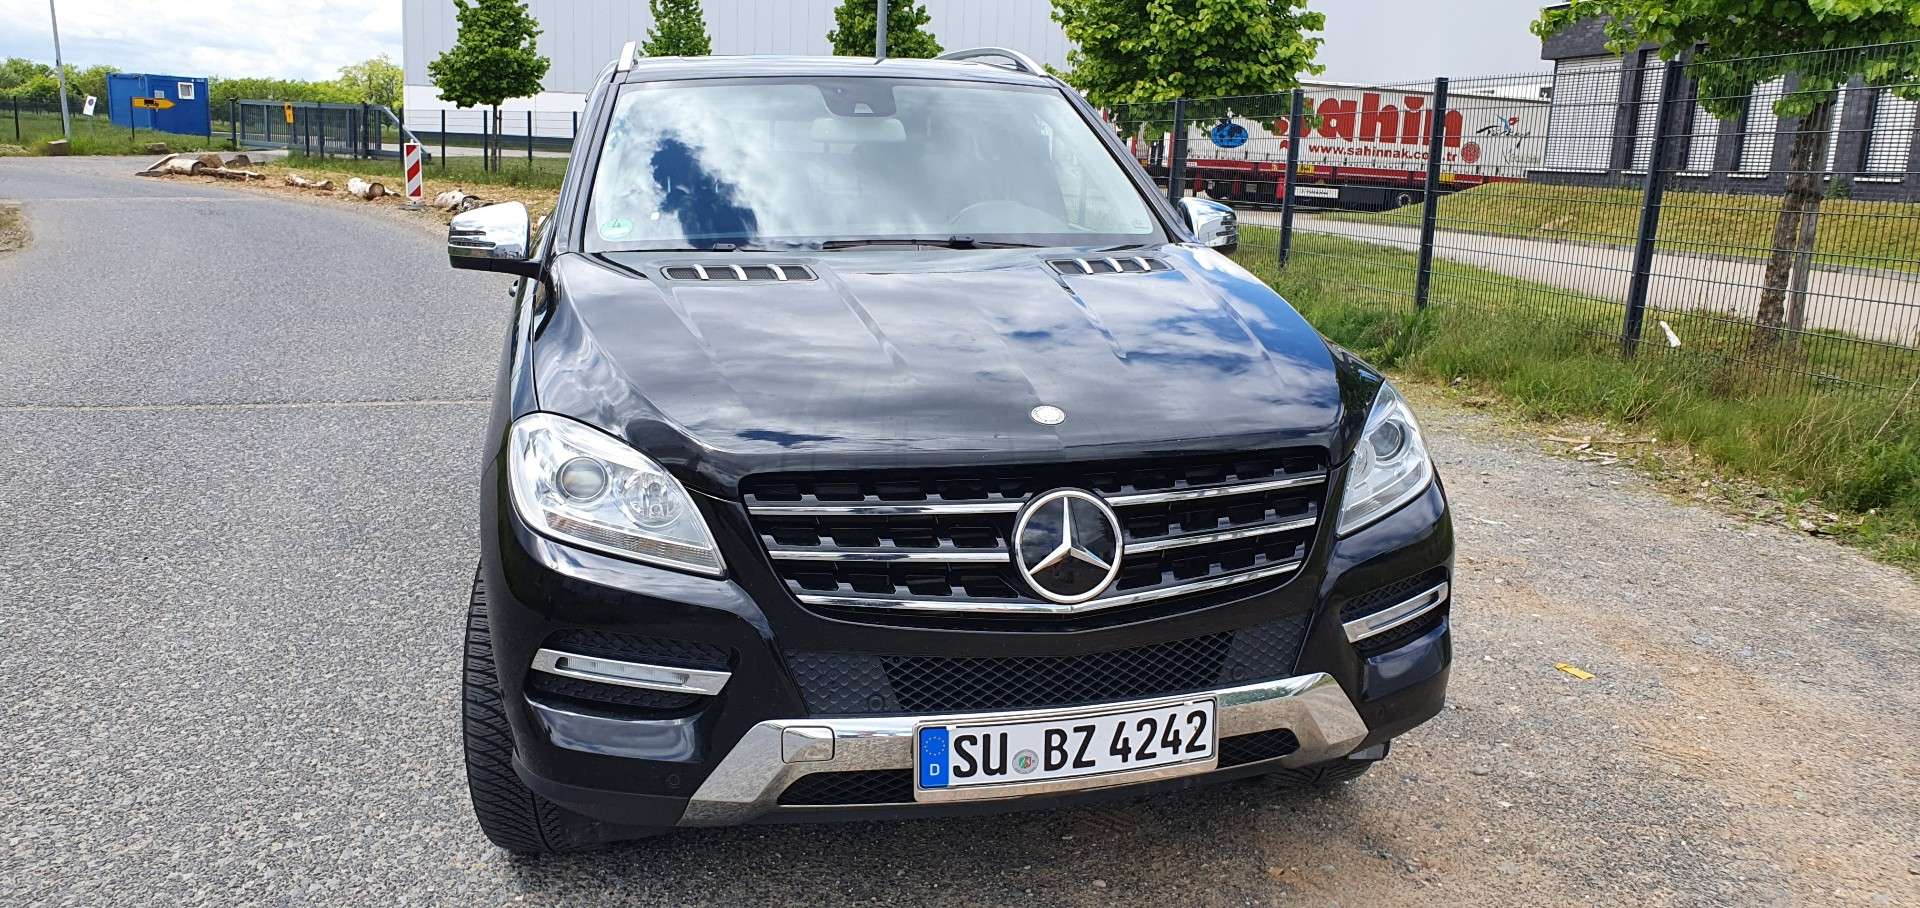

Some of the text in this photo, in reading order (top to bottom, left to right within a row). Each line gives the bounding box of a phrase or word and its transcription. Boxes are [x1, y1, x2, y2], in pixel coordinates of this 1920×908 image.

[1309, 143, 1457, 163] www.sahinnak.co.tr
[953, 732, 1008, 778] SU
[1043, 724, 1096, 772] BZ
[1109, 710, 1208, 763] 4242
[929, 763, 940, 776] D
